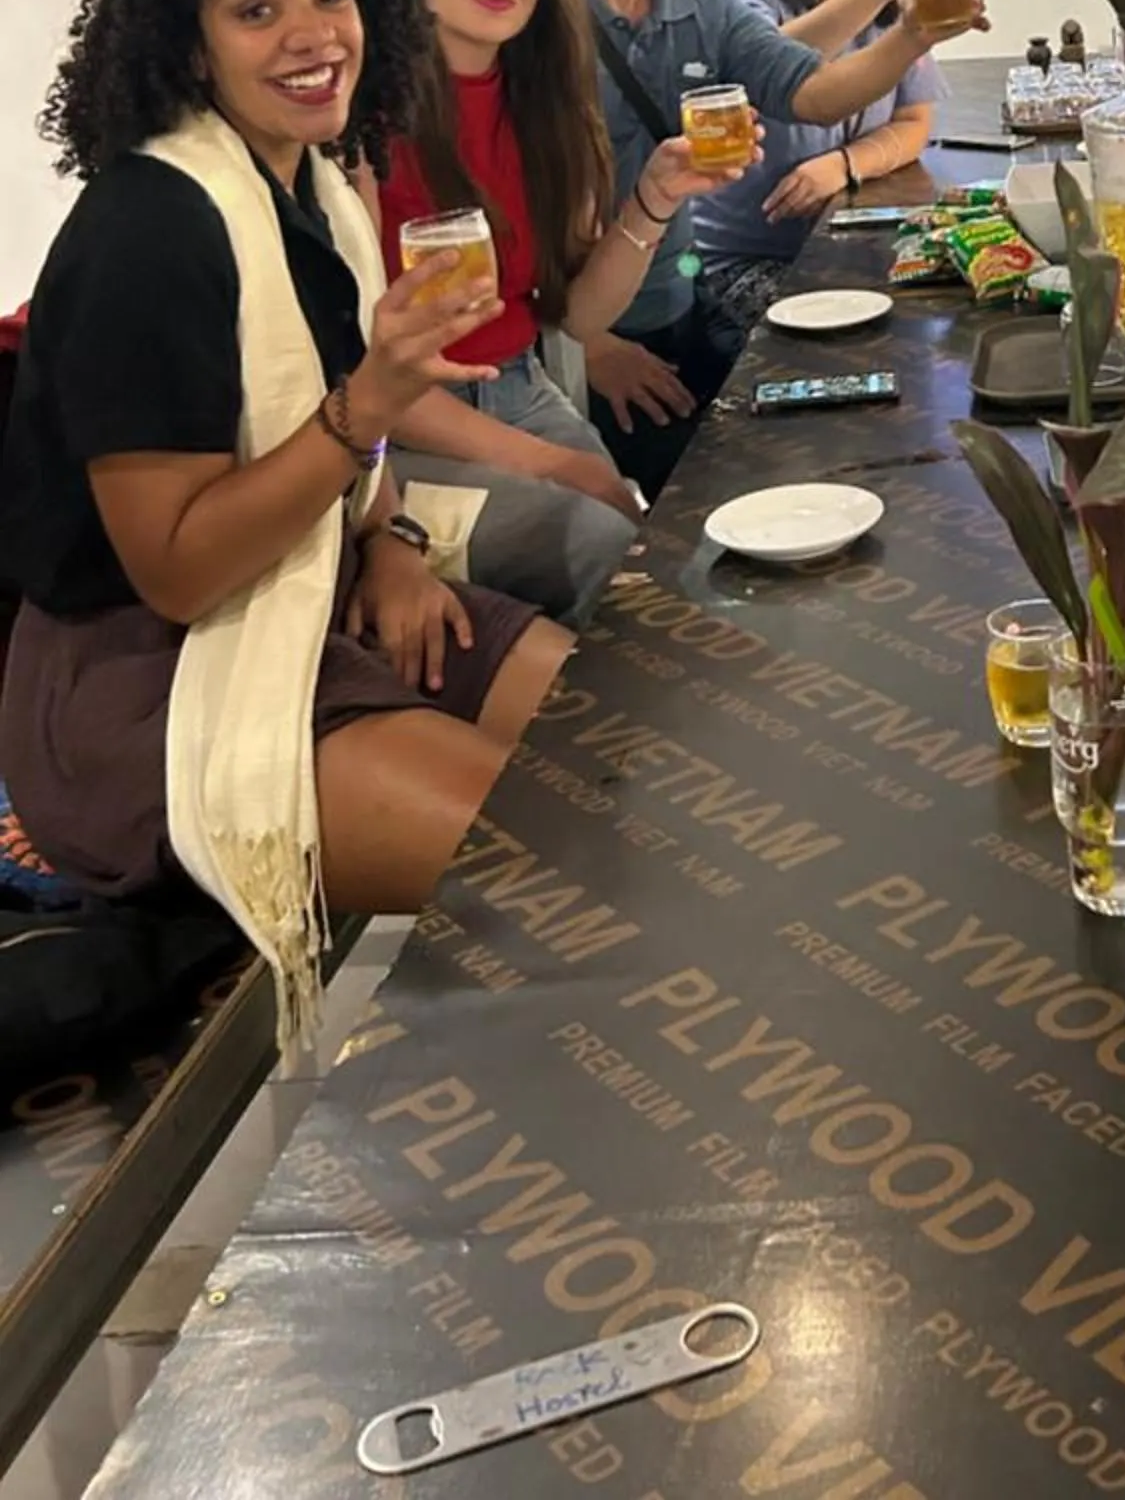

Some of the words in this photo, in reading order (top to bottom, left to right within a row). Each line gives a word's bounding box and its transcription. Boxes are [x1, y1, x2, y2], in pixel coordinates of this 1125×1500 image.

[750, 650, 1021, 788] VIETNAM
[574, 711, 845, 873] VIETNAM
[452, 944, 529, 995] NAM
[774, 921, 924, 1015] PREMIUM
[921, 1013, 1015, 1074] FILM
[547, 1022, 694, 1132] PREMIUM
[621, 968, 1035, 1254] PLYWOOD
[408, 1271, 504, 1357] FILM
